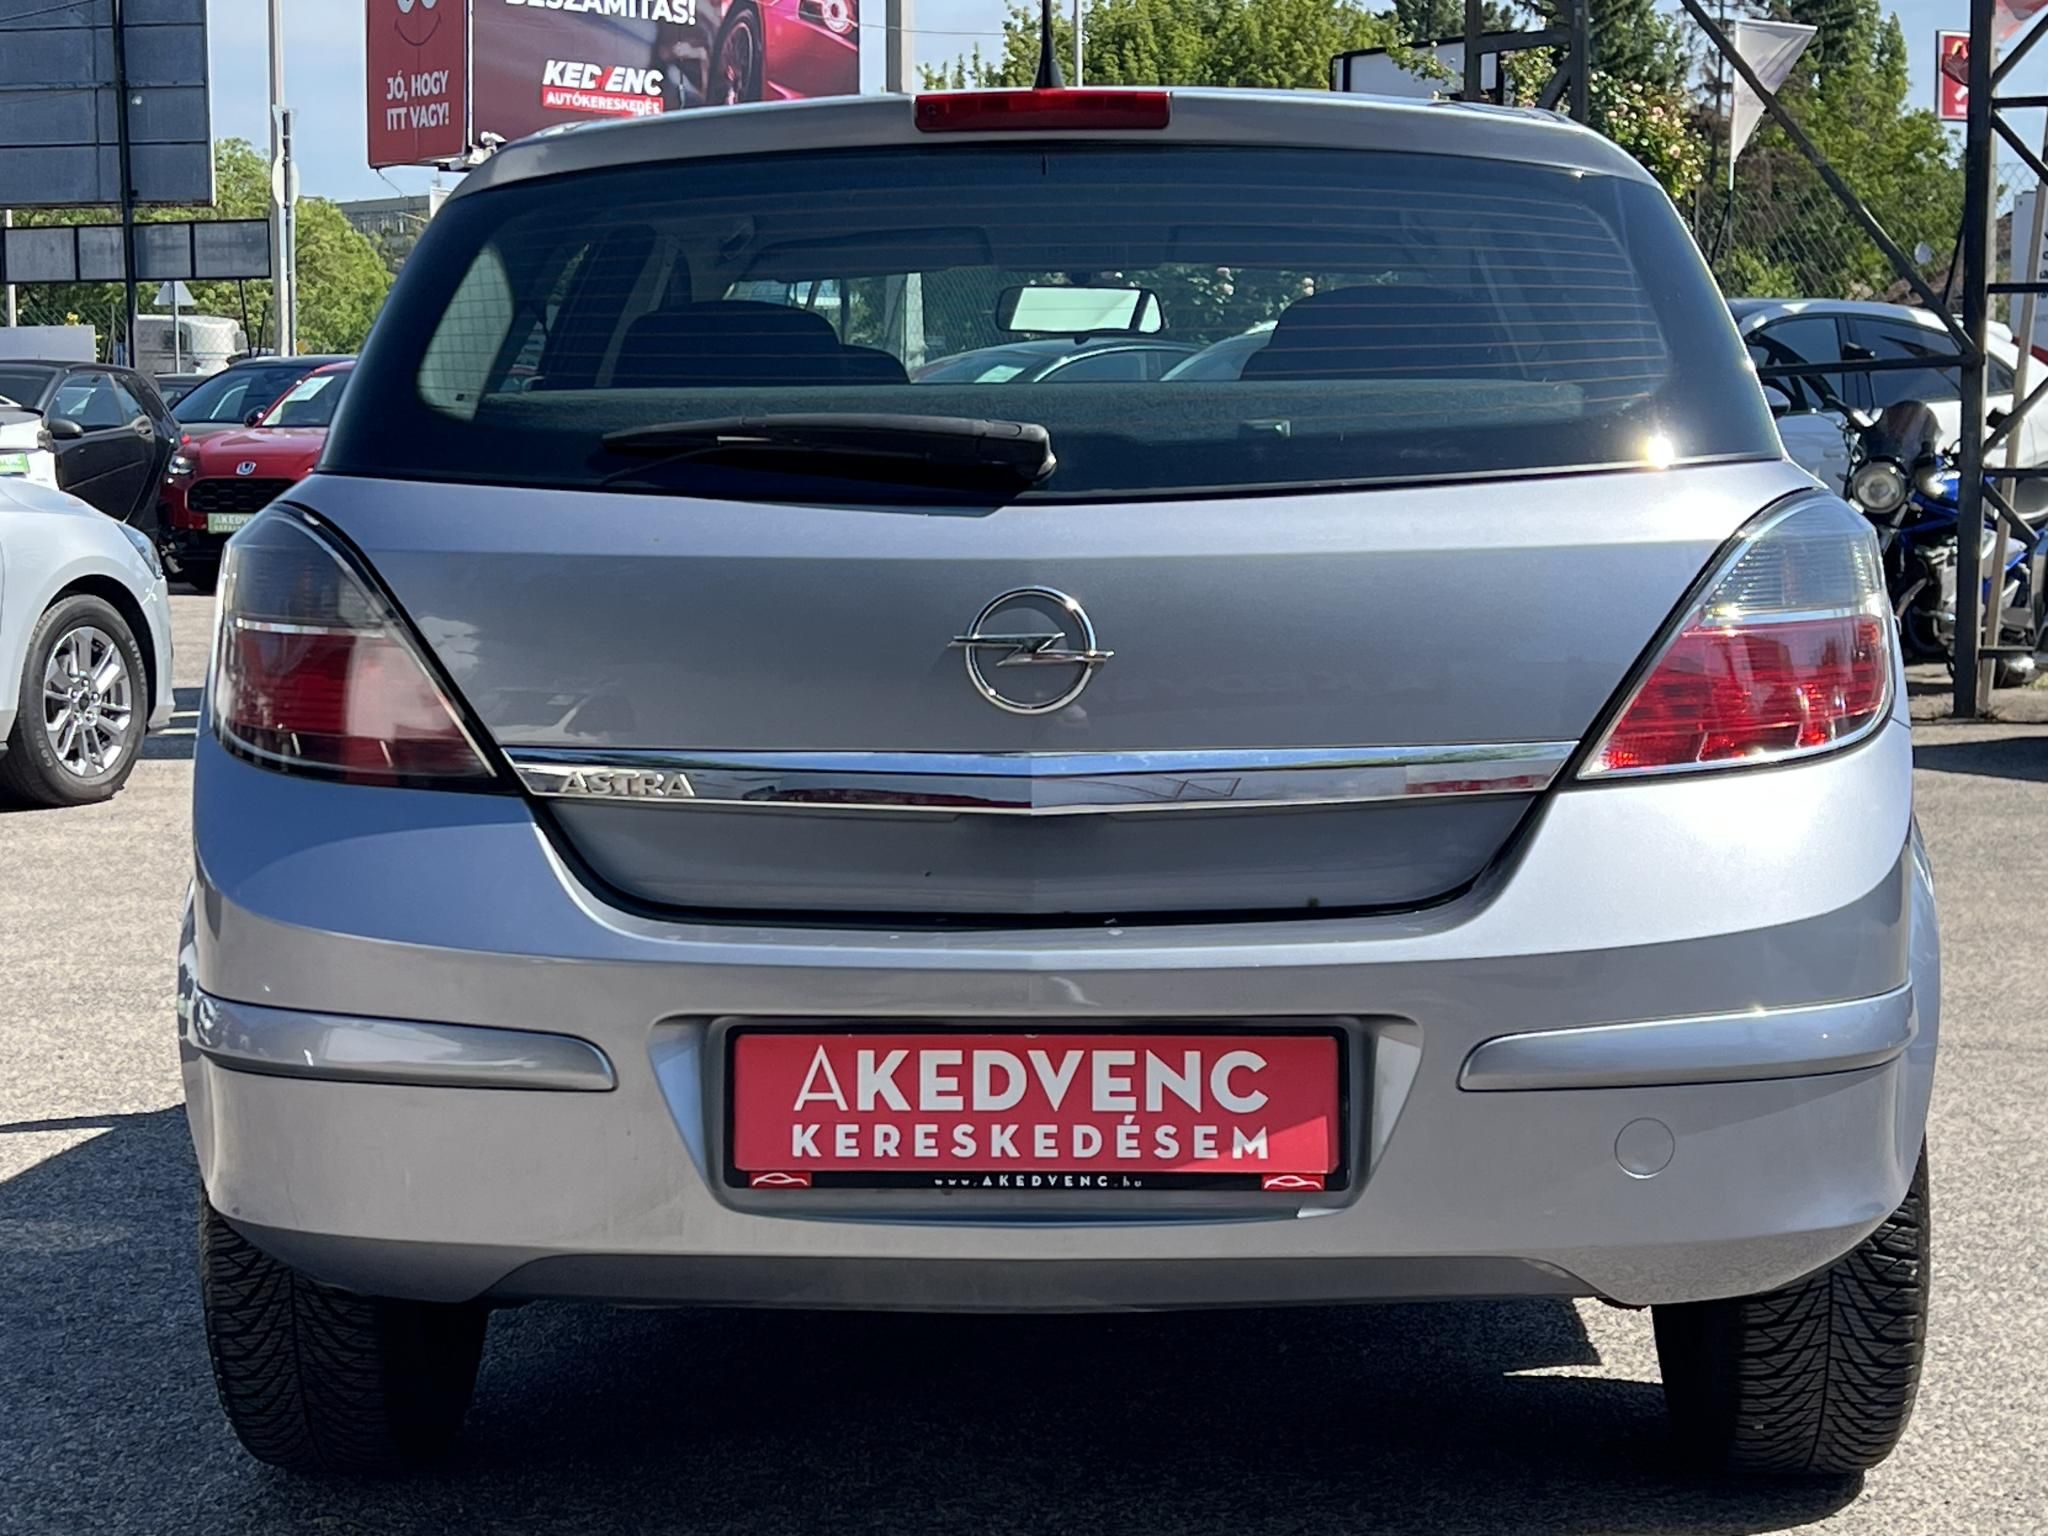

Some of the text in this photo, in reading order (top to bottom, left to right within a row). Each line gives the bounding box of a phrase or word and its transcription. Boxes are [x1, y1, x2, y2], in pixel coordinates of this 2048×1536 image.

[386, 70, 449, 102] JÓ, HOGY
[386, 102, 449, 131] ITT VAGY!
[546, 91, 661, 116] AUTÓKERESKEDÉS
[559, 770, 696, 797] ASTRA
[793, 1045, 1269, 1113] AKEDVENC
[792, 1114, 1269, 1160] KERESKEDÉSEM
